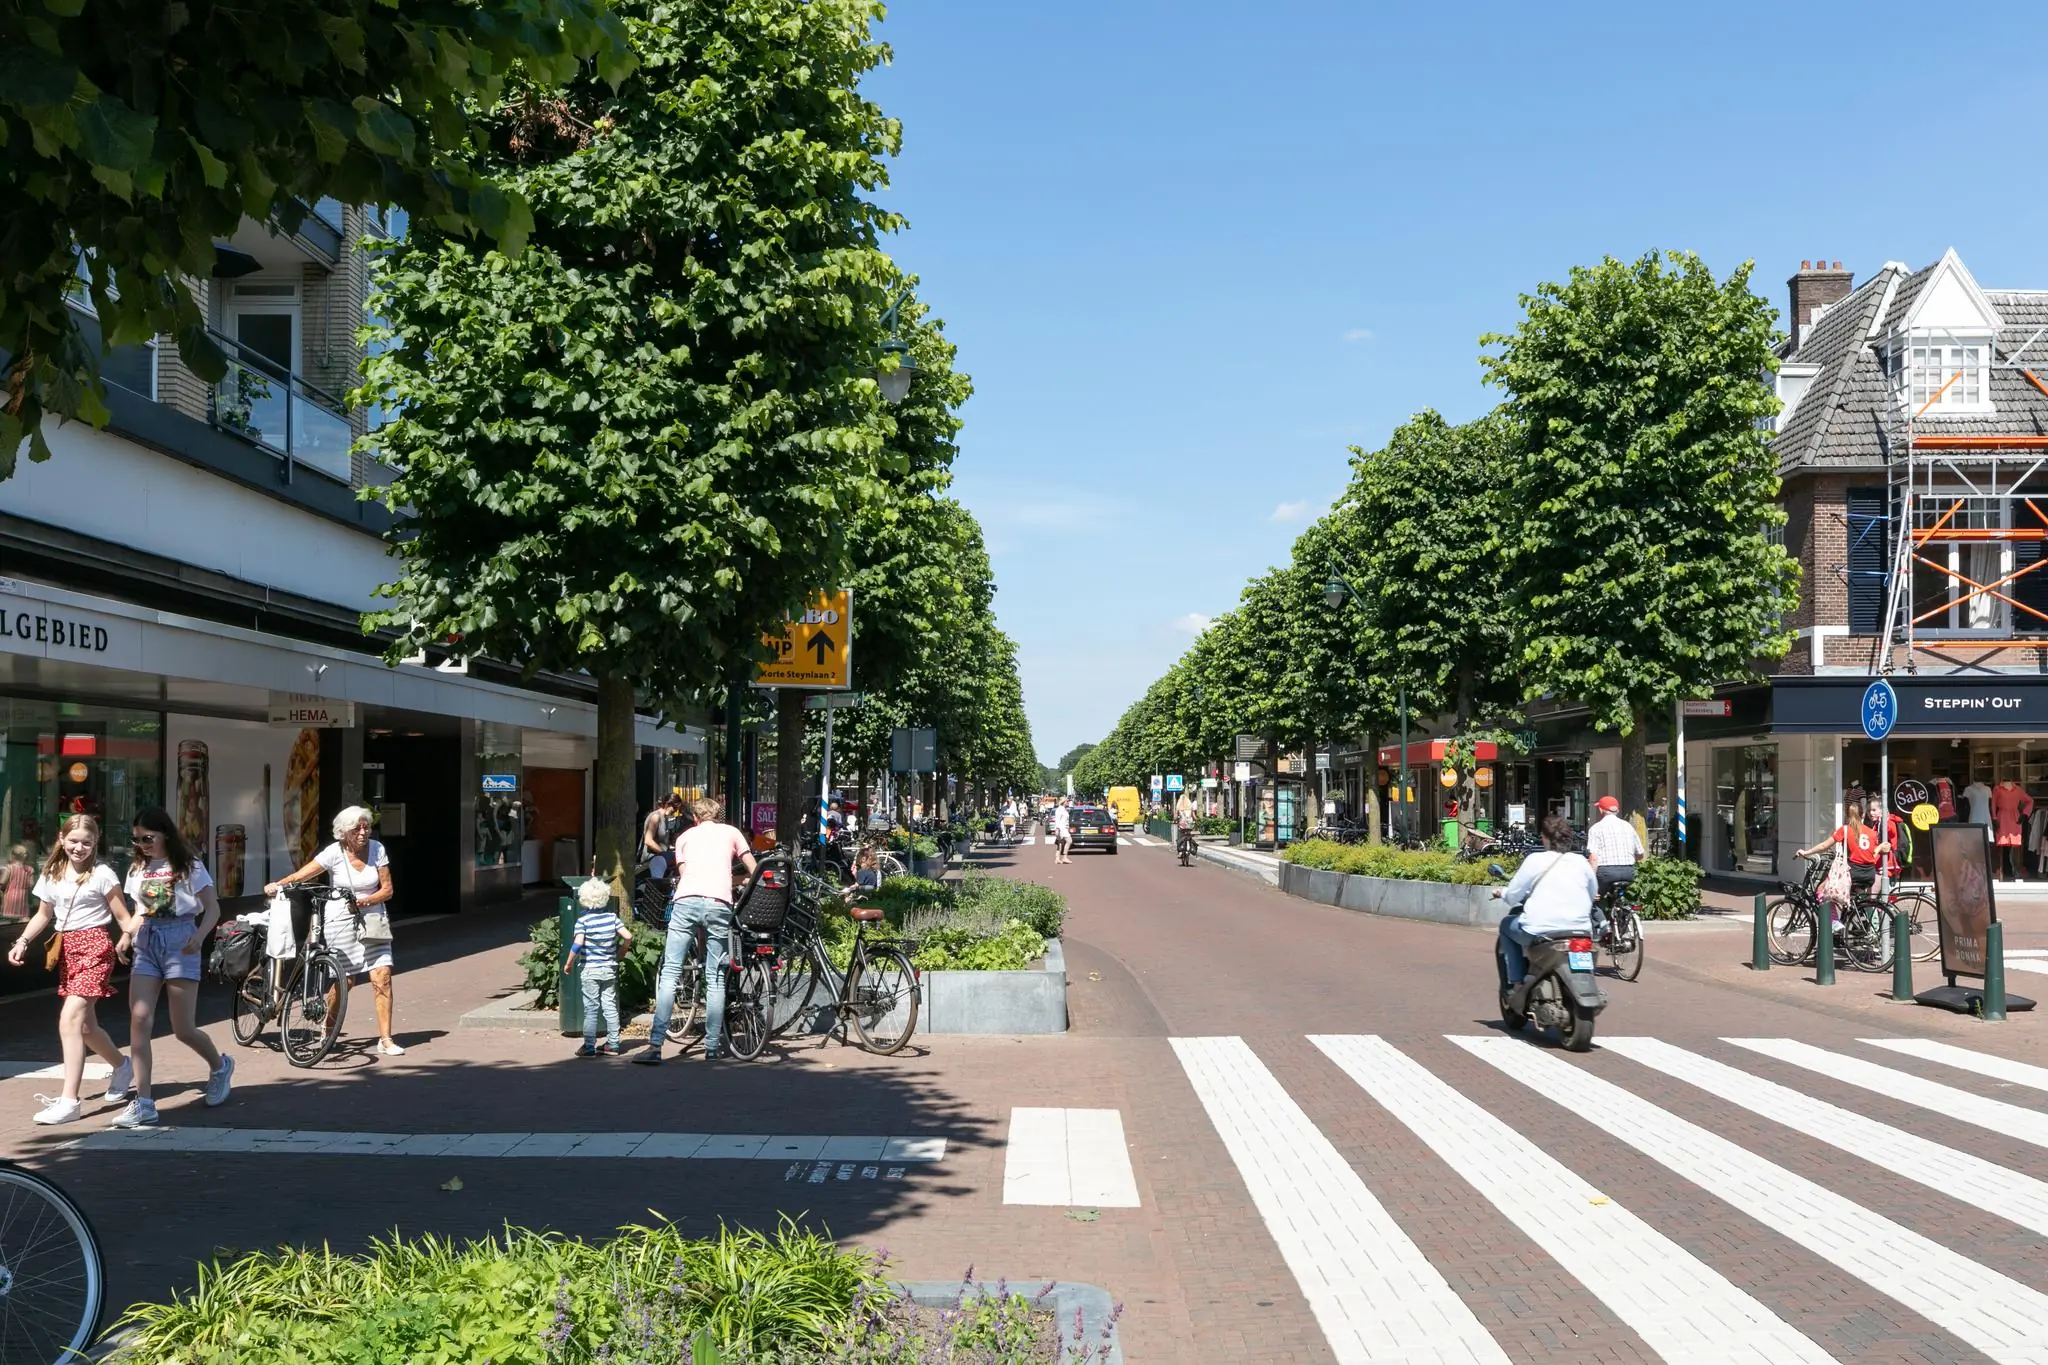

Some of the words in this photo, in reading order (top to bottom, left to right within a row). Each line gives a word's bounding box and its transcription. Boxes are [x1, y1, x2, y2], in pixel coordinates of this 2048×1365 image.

[0, 609, 108, 651] LGEBIED
[761, 670, 785, 678] Korte
[787, 671, 829, 680] Steynlaan
[289, 709, 328, 721] HEMA
[1897, 788, 1926, 806] Sale
[757, 811, 776, 823] SALE
[1914, 808, 1938, 823] 30%
[1859, 833, 1870, 850] 6
[1954, 935, 1979, 949] PRIMA
[1955, 950, 1984, 966] DONNA
